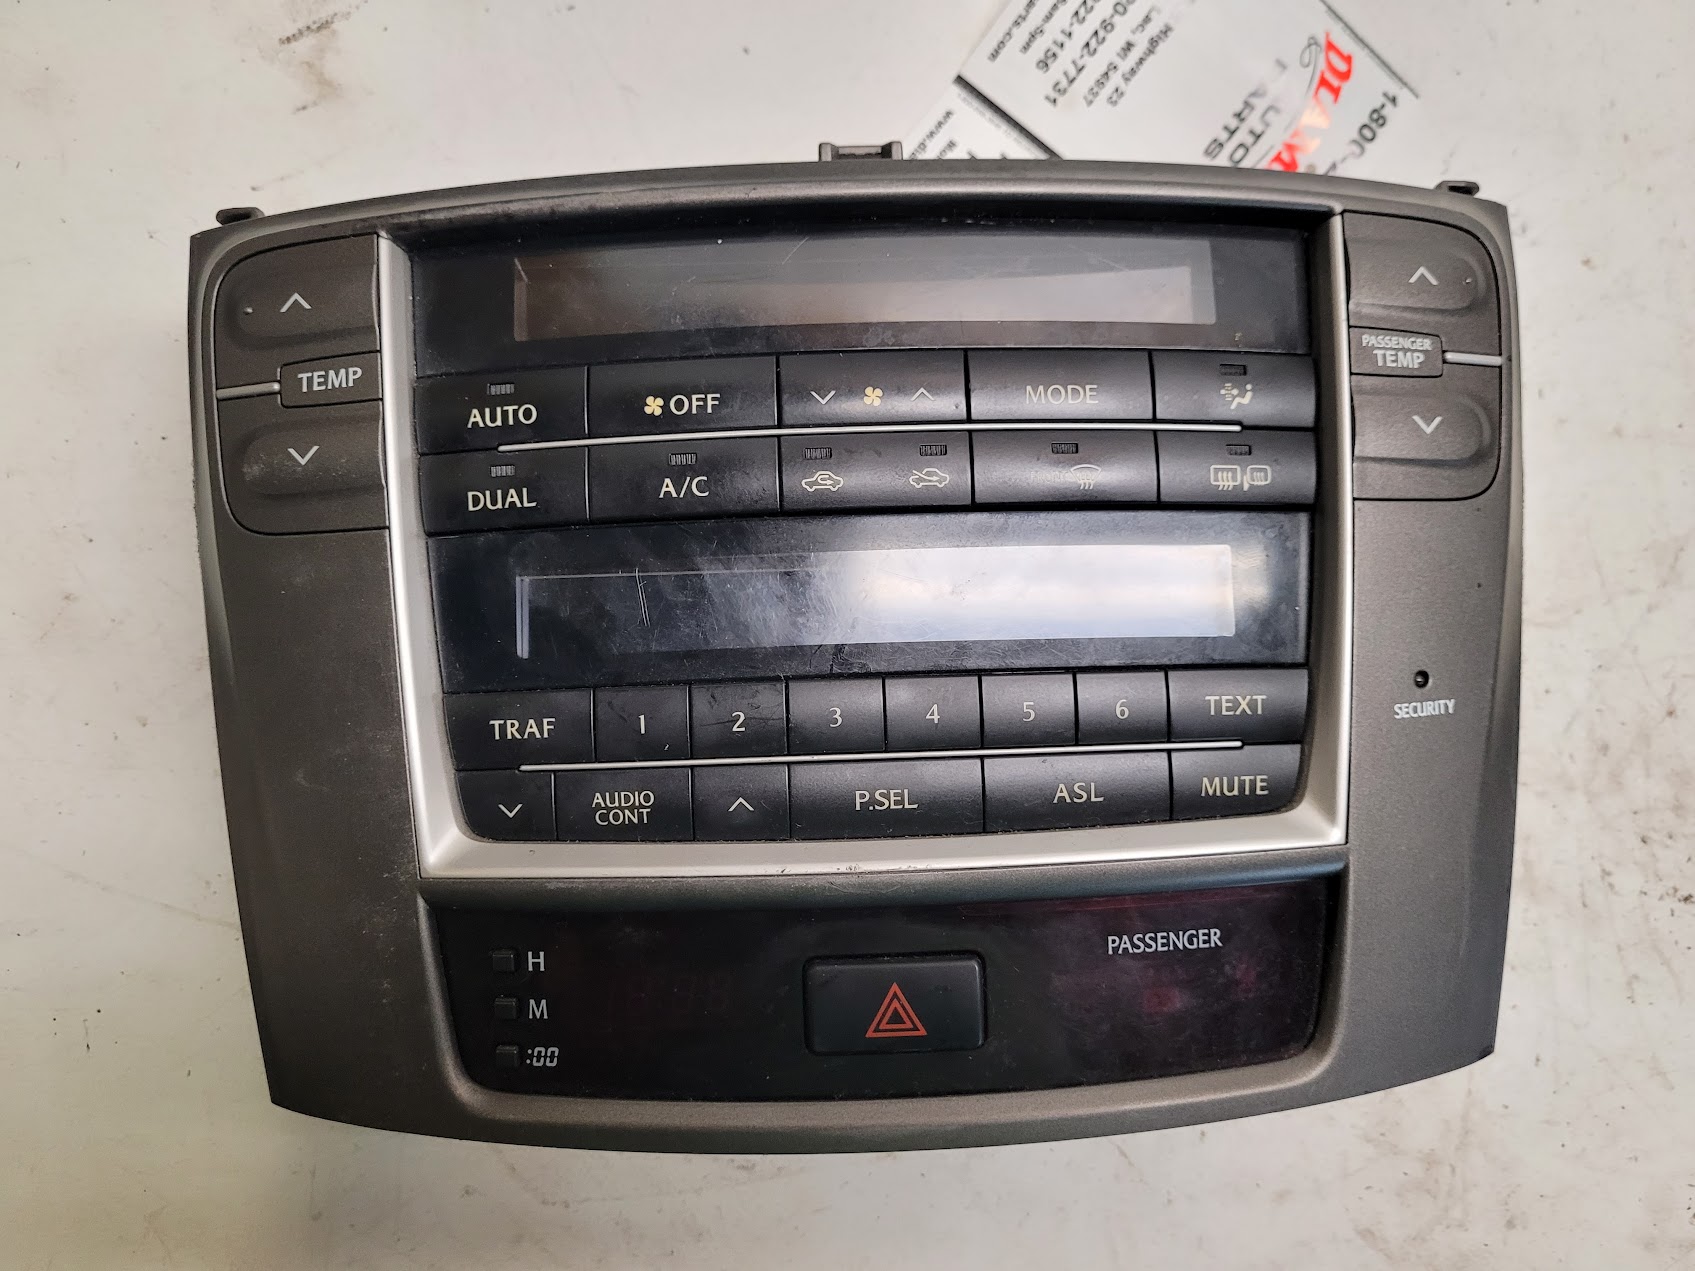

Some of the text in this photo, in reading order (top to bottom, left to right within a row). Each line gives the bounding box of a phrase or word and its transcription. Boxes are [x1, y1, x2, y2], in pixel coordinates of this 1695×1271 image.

[1035, 0, 1101, 74] 22-1156
[1120, 22, 1174, 85] Highway
[1361, 333, 1432, 351] PASSENGER
[1373, 349, 1425, 369] TEMP
[297, 366, 363, 393] TEMP
[669, 393, 721, 416] OFF
[1025, 384, 1099, 405] MODE
[467, 404, 538, 429] AUTO
[658, 475, 710, 499] A/C
[467, 487, 538, 512] DUAL
[924, 703, 941, 725] 4
[1022, 701, 1036, 723] 5
[1114, 699, 1129, 720] 6
[1205, 694, 1267, 716] TEXT
[1393, 699, 1456, 719] SECURITY
[638, 714, 646, 735] 1
[731, 711, 747, 733] 2
[828, 707, 843, 728] 3
[489, 717, 556, 741] TRAF
[1052, 782, 1105, 804] ASL
[1200, 774, 1270, 798] MUTE
[592, 790, 655, 809] AUDIO
[854, 789, 919, 812] P.SEL
[594, 808, 651, 827] CONT
[1107, 928, 1223, 955] PASSENGER
[527, 951, 546, 972] H
[528, 999, 549, 1020] M
[525, 1046, 560, 1068] :00
